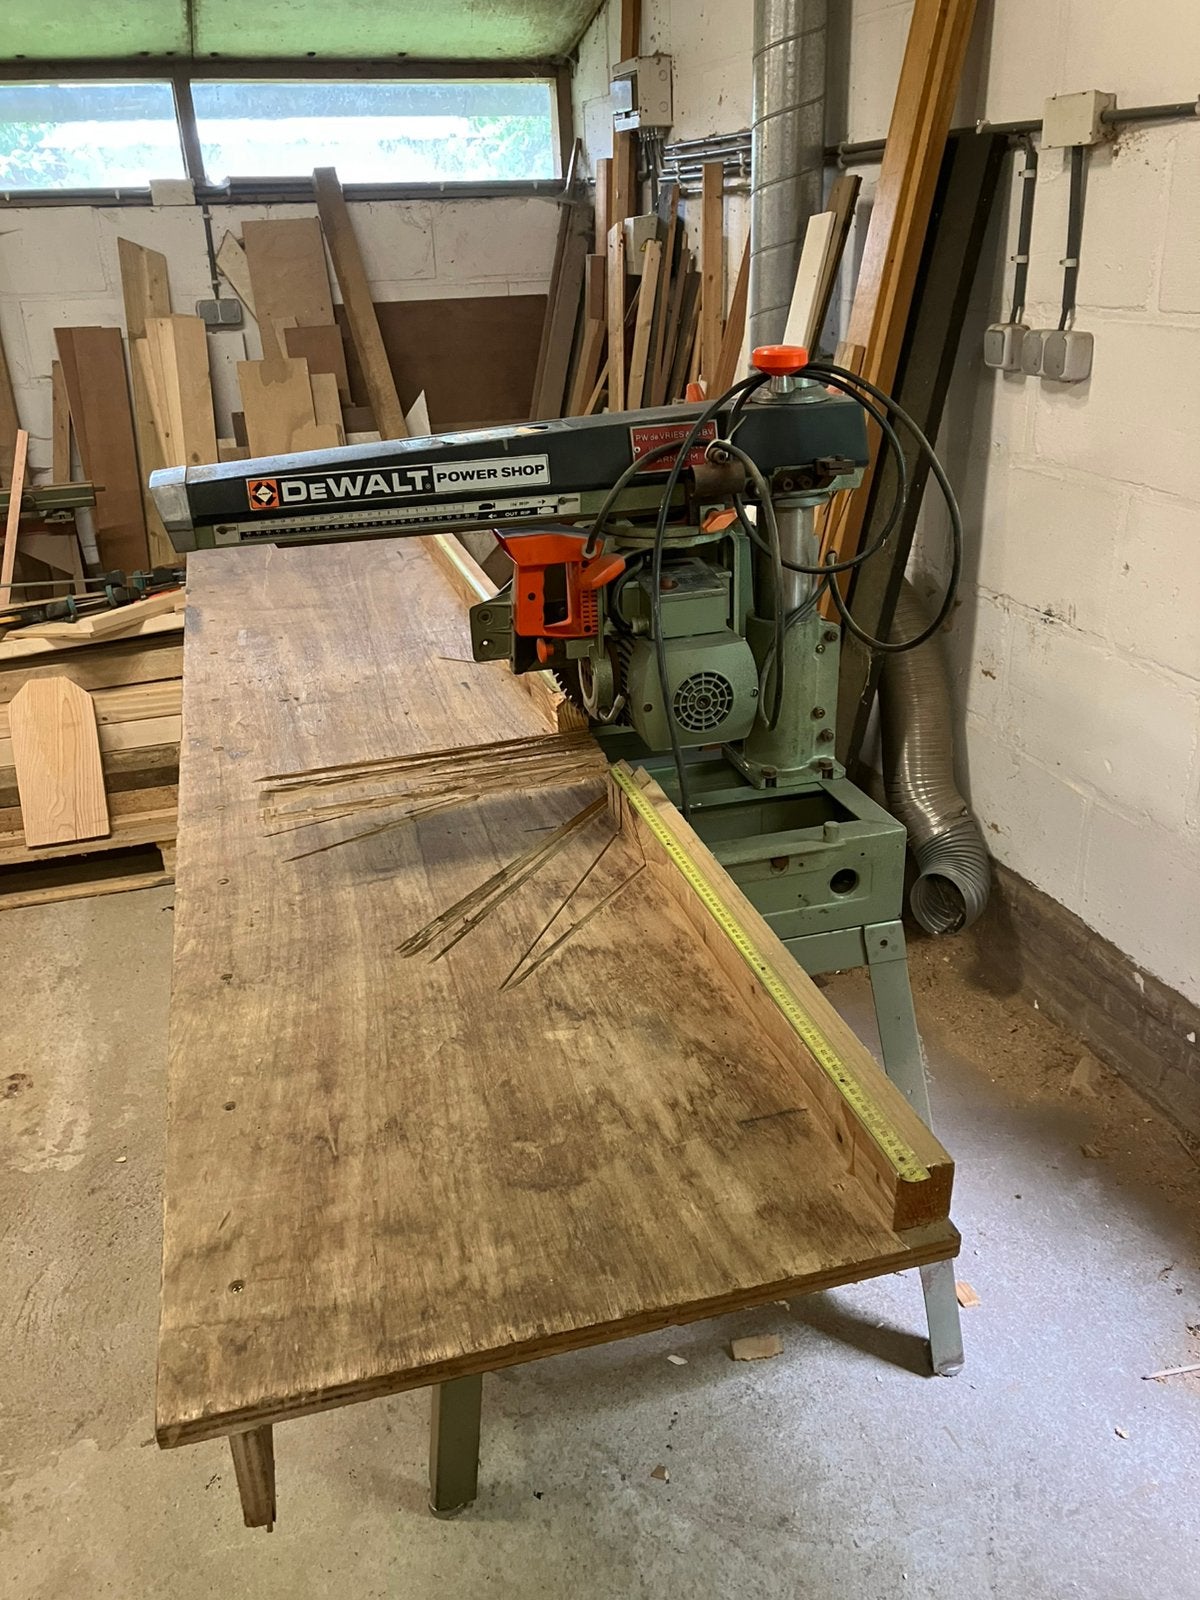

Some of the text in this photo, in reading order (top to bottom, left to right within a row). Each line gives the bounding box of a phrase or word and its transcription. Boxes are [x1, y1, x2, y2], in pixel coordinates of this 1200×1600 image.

[659, 430, 685, 440] VRIES
[436, 468, 498, 483] POWER
[501, 464, 545, 478] SHOP
